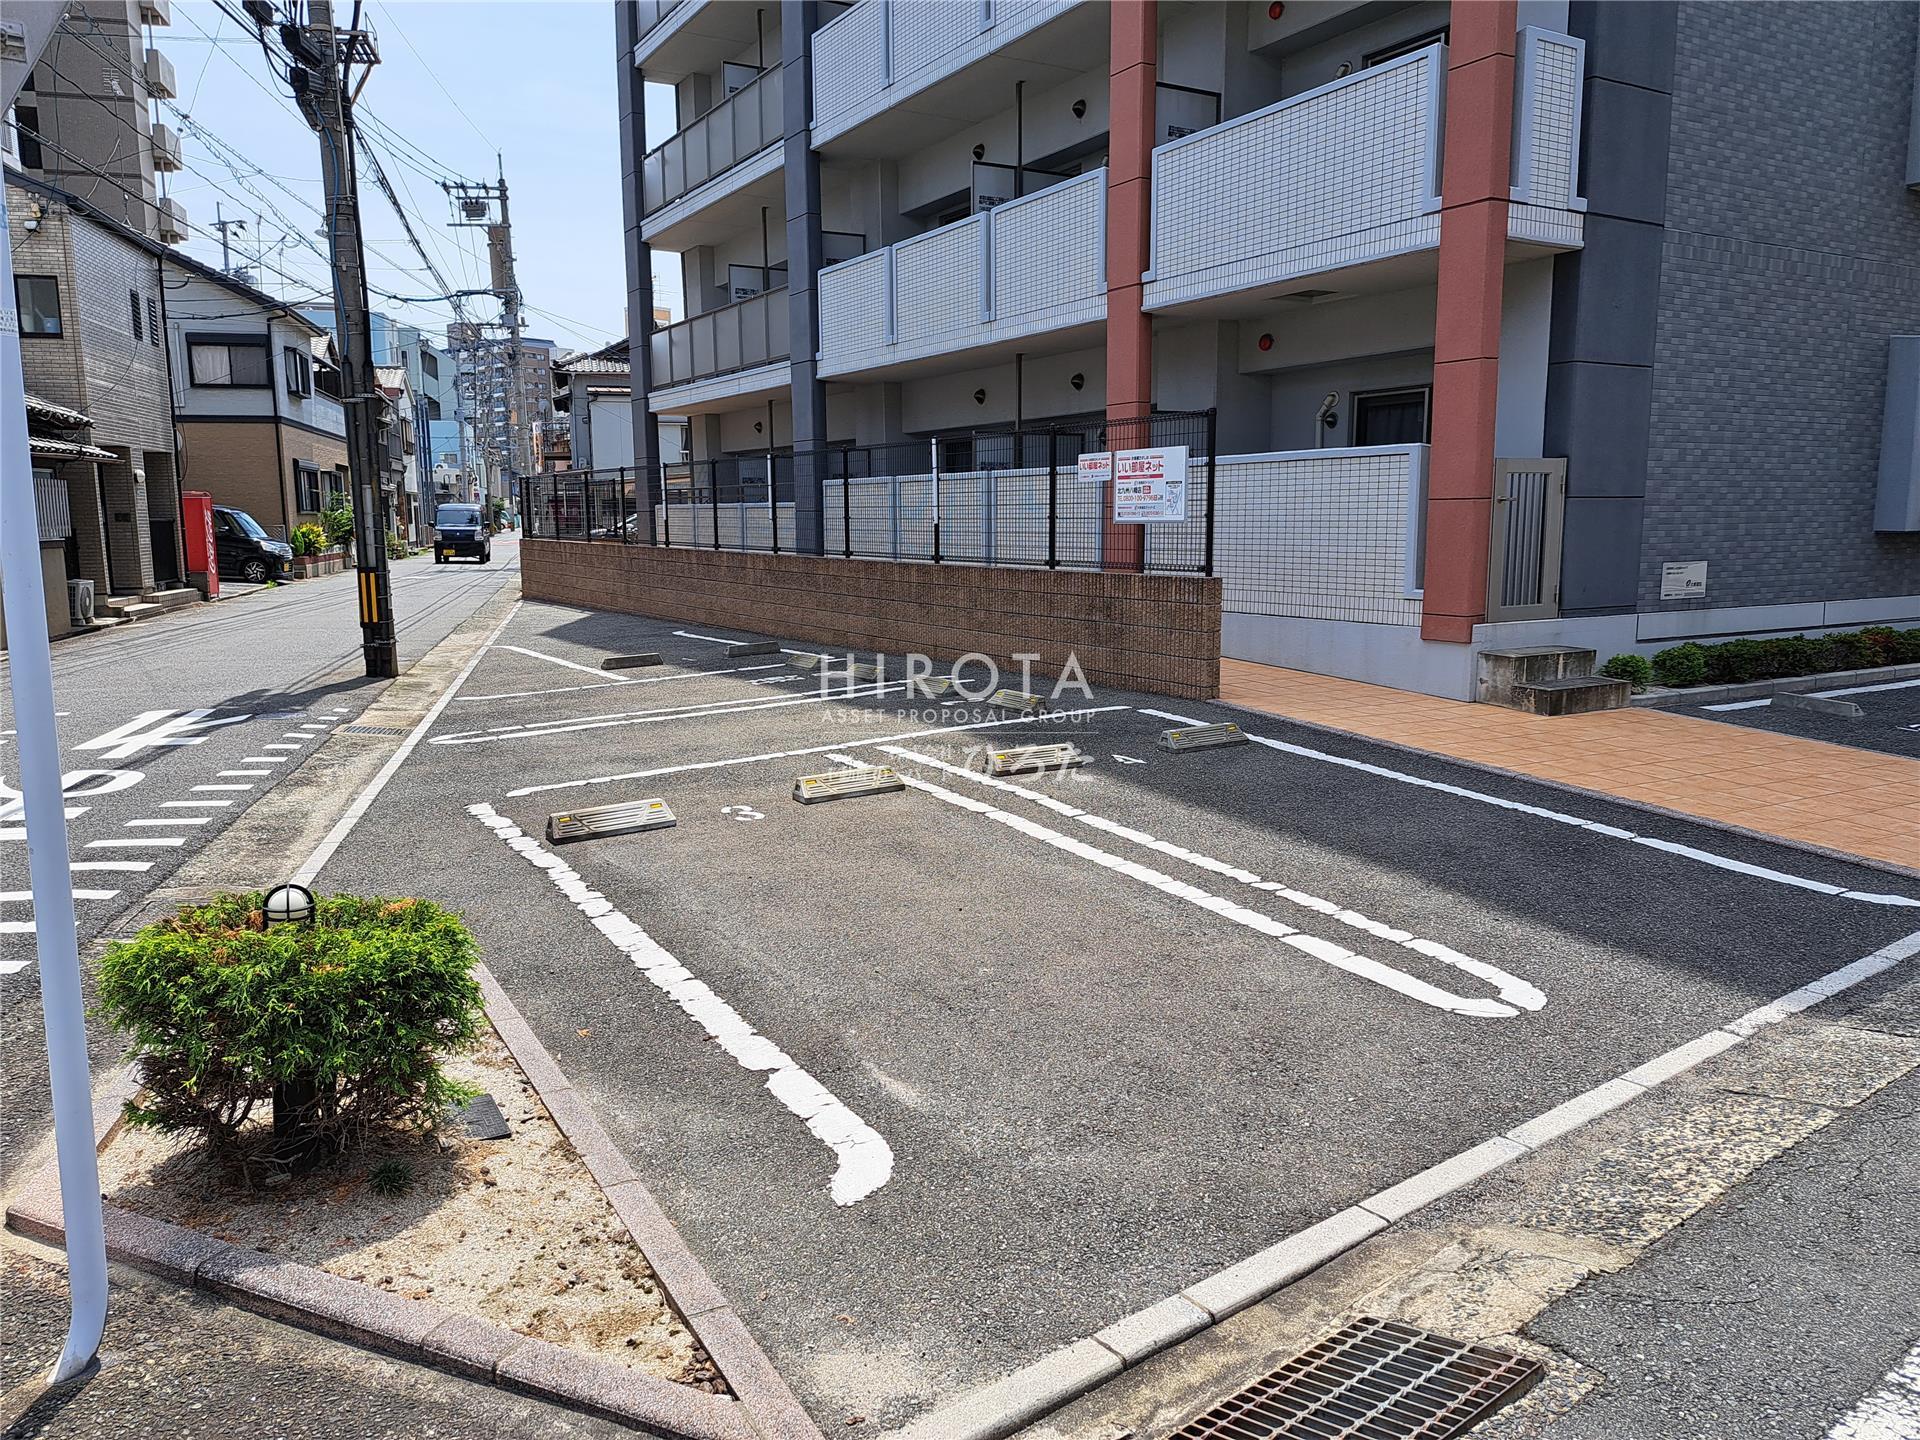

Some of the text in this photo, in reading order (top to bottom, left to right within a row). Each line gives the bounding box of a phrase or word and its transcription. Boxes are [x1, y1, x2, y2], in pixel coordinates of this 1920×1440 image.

[1117, 460, 1164, 474] いい部屋ネット
[1111, 754, 1148, 764] 4
[720, 805, 766, 821] 3
